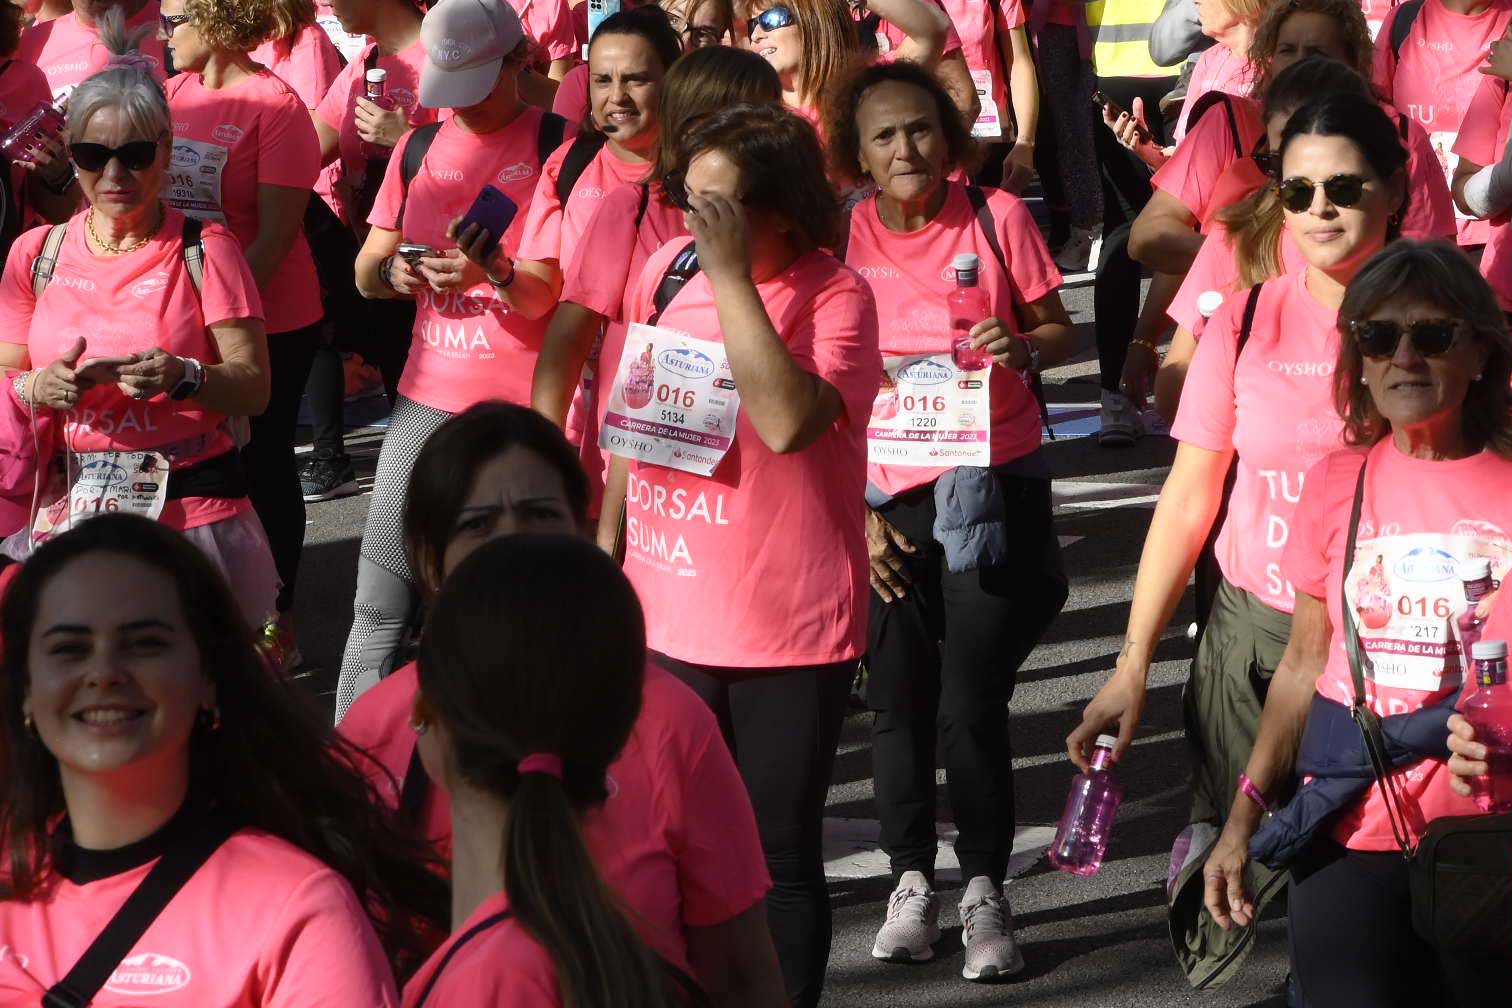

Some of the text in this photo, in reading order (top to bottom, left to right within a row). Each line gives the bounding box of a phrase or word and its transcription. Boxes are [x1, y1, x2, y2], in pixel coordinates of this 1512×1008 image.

[1416, 38, 1455, 53] OYSHO
[47, 61, 88, 75] OYSHO
[1408, 103, 1435, 125] TU
[663, 353, 710, 376] ASTURIANA
[903, 365, 949, 379] ASTURIANA
[1268, 358, 1334, 377] OYSHO
[656, 383, 697, 409] 016
[903, 395, 946, 412] 016
[660, 409, 685, 425] 5134
[911, 417, 937, 428] 1220
[620, 419, 656, 433] CARRERA
[658, 427, 668, 436] DE
[669, 429, 678, 438] LA
[679, 432, 702, 442] MUJER
[610, 434, 653, 454] OYSHO
[873, 445, 908, 457] OYSHO
[1259, 470, 1304, 504] TU
[74, 497, 119, 513] 016
[628, 472, 729, 525] DORSAL
[628, 516, 693, 565] SUMA
[1397, 595, 1450, 619] 016
[1365, 641, 1408, 652] CARRERA
[1408, 644, 1421, 654] DE
[1421, 645, 1434, 655] LA
[111, 972, 182, 985] ASTURIANA
